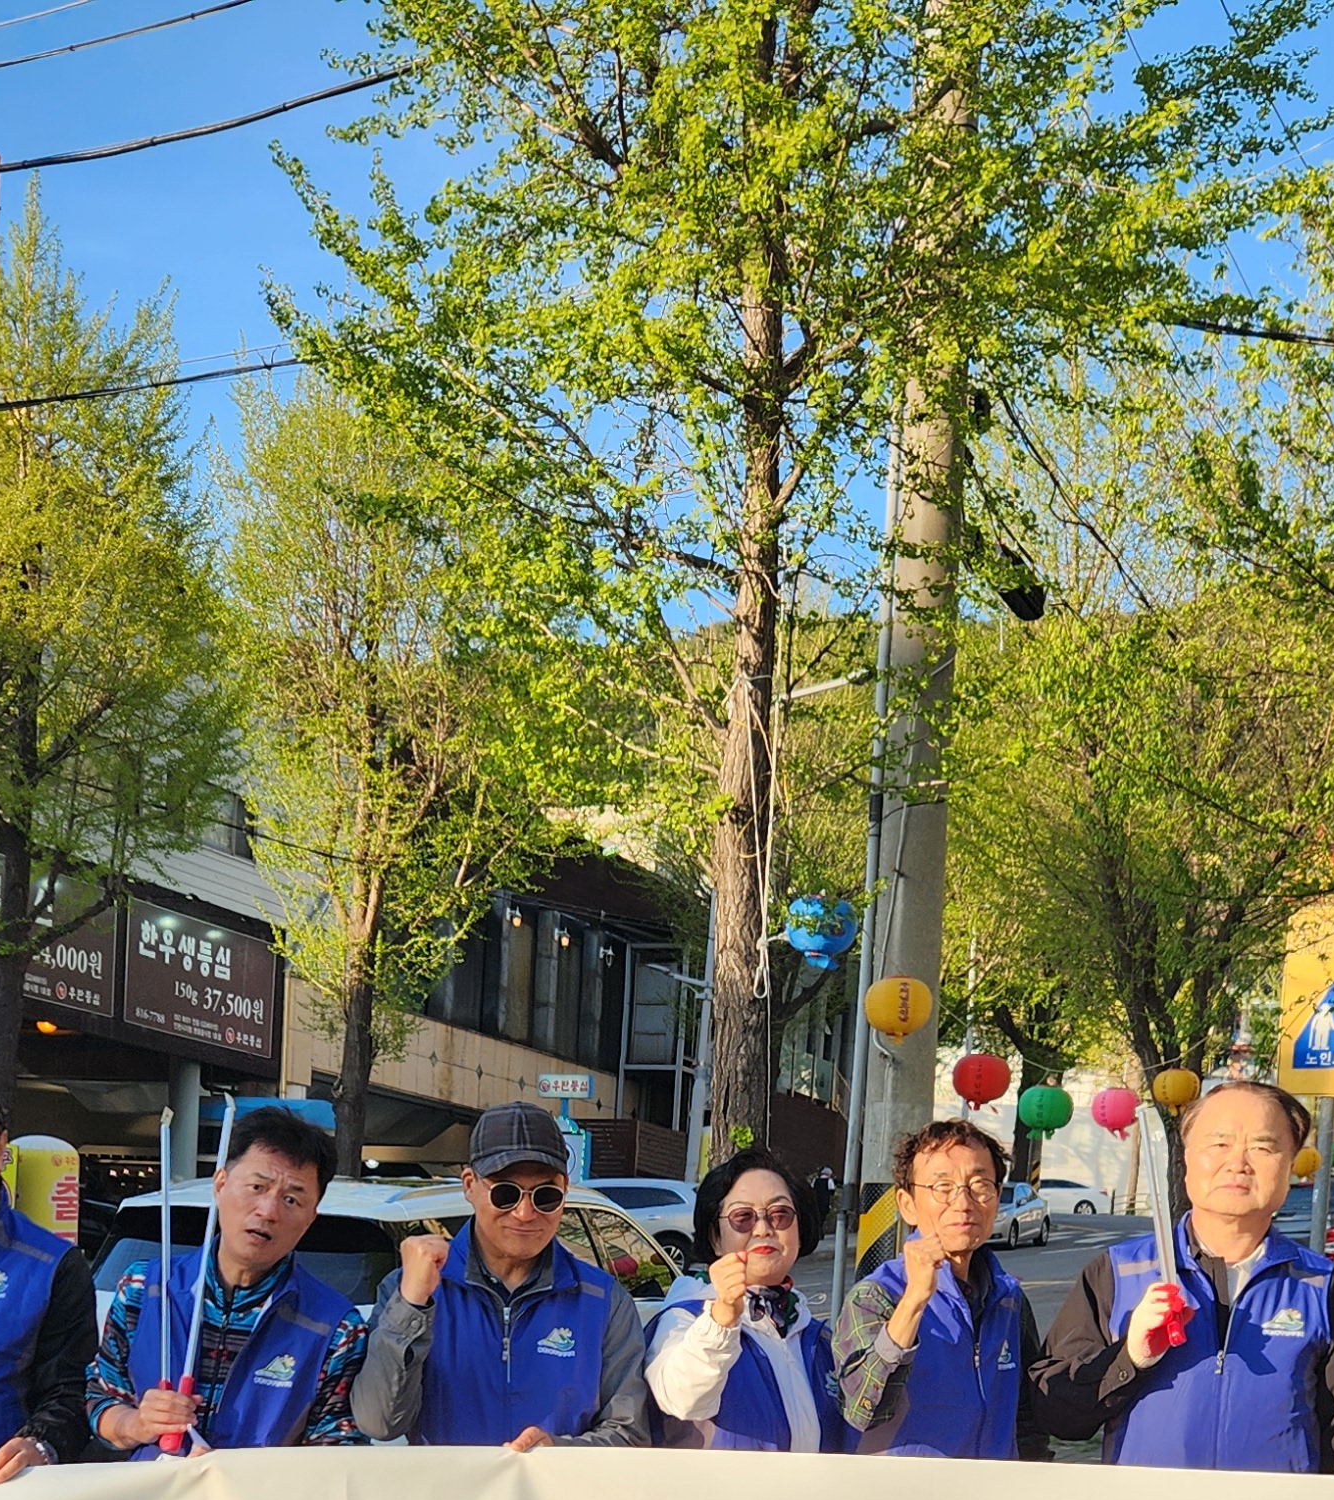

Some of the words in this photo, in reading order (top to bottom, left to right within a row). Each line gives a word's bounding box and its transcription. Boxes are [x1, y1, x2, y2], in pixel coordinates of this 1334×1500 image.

[32, 944, 103, 980] 4,000원
[139, 919, 231, 981] 한우생등심
[135, 1007, 166, 1024] 816-7788
[175, 980, 199, 1006] 150g
[203, 987, 264, 1025] 37,500원
